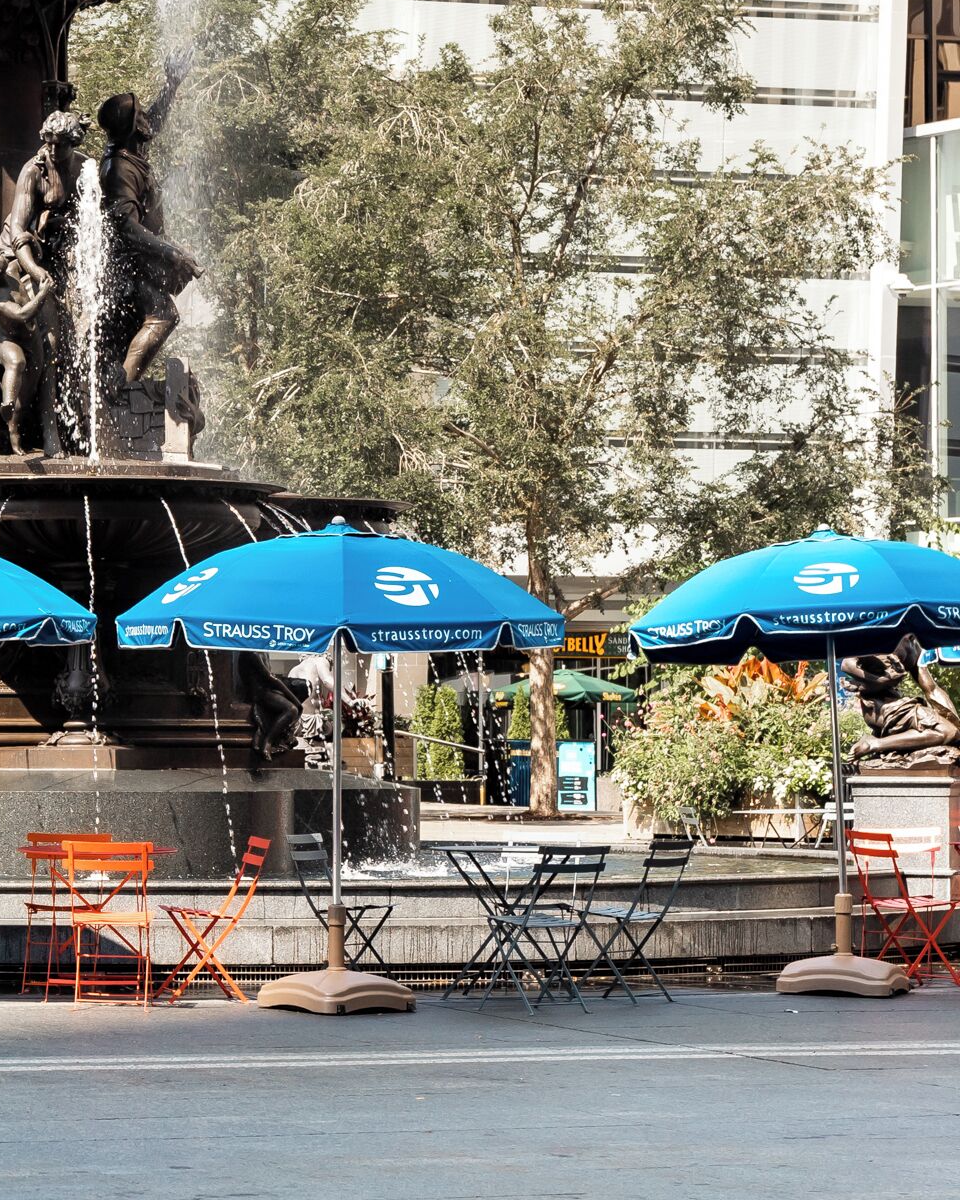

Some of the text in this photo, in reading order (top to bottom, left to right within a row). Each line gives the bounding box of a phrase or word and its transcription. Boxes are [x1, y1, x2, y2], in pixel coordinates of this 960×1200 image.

[125, 623, 169, 638] strausstroy.com
[203, 621, 315, 641] STRAUSS TROY
[371, 628, 482, 644] strausstroy.com
[517, 623, 543, 637] STRAUSS
[647, 625, 693, 639] STRAUSS
